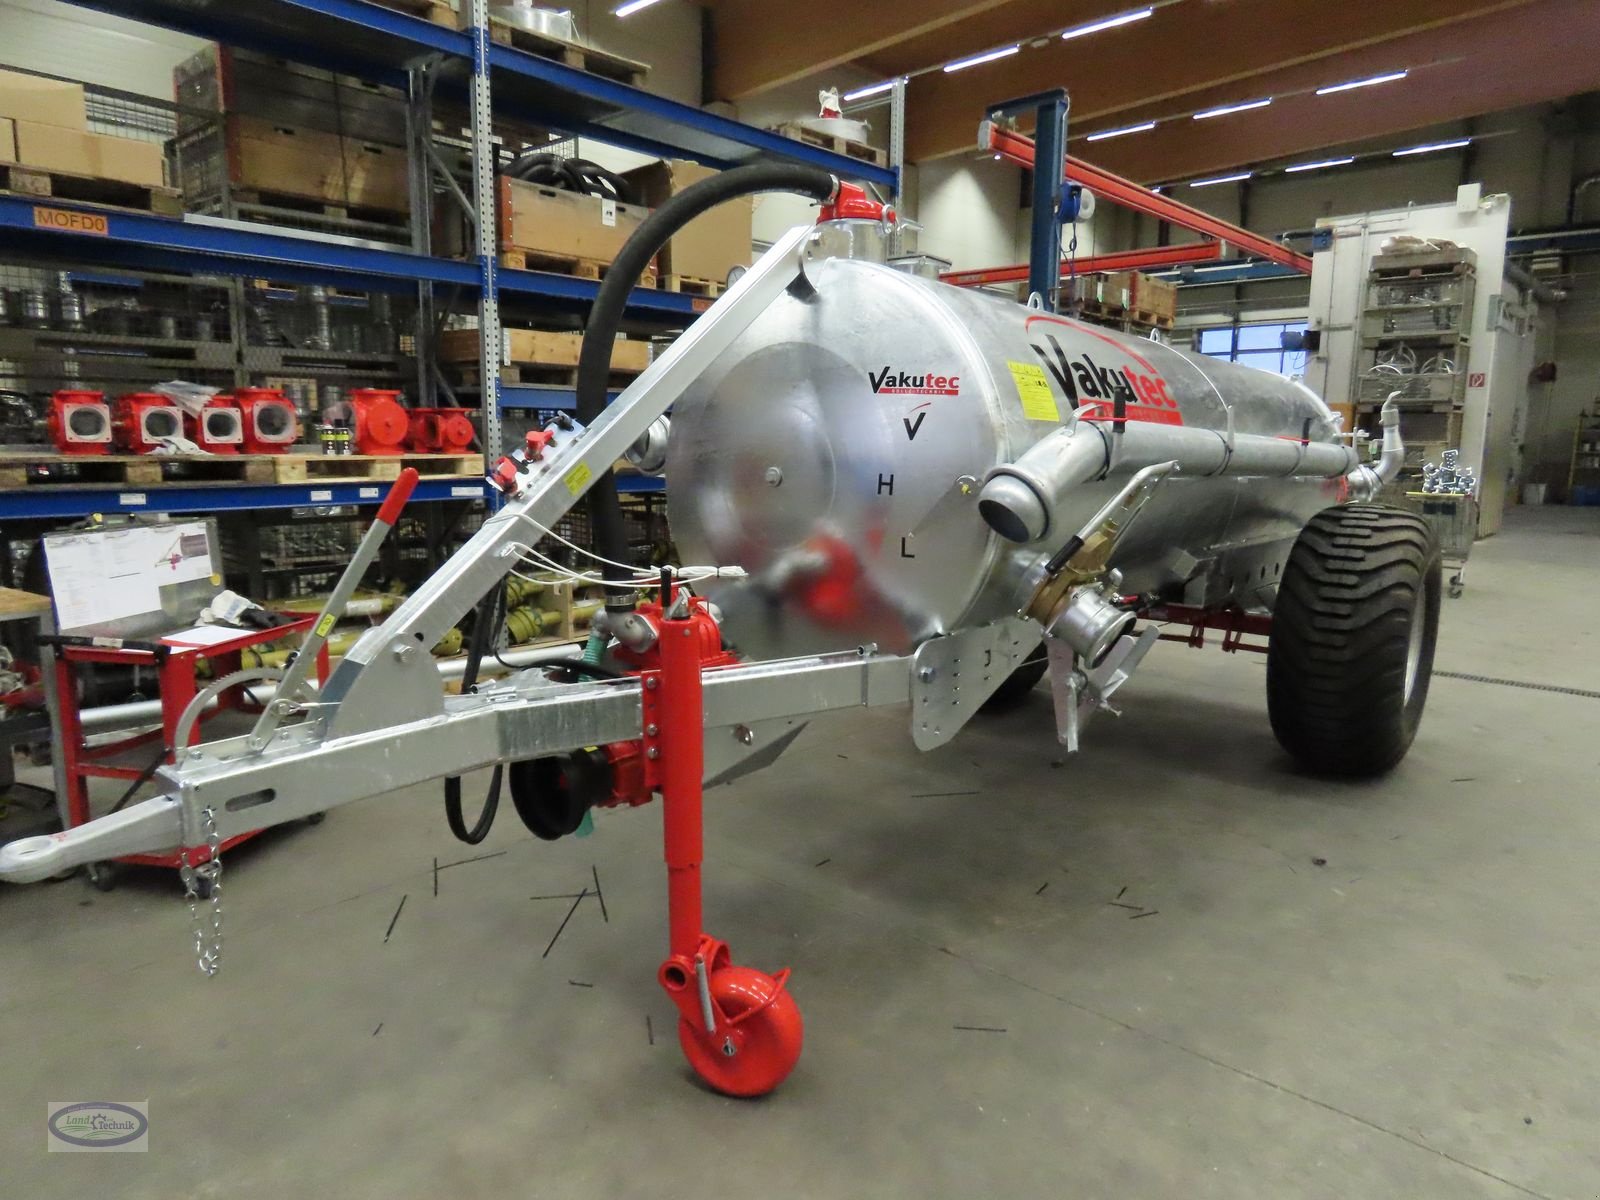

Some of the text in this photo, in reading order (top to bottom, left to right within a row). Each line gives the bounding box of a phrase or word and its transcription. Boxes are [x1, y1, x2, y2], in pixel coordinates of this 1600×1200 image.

[868, 366, 960, 394] Vakutec
[1029, 334, 1178, 411] Vakutec
[877, 473, 894, 496] H
[901, 537, 915, 558] L
